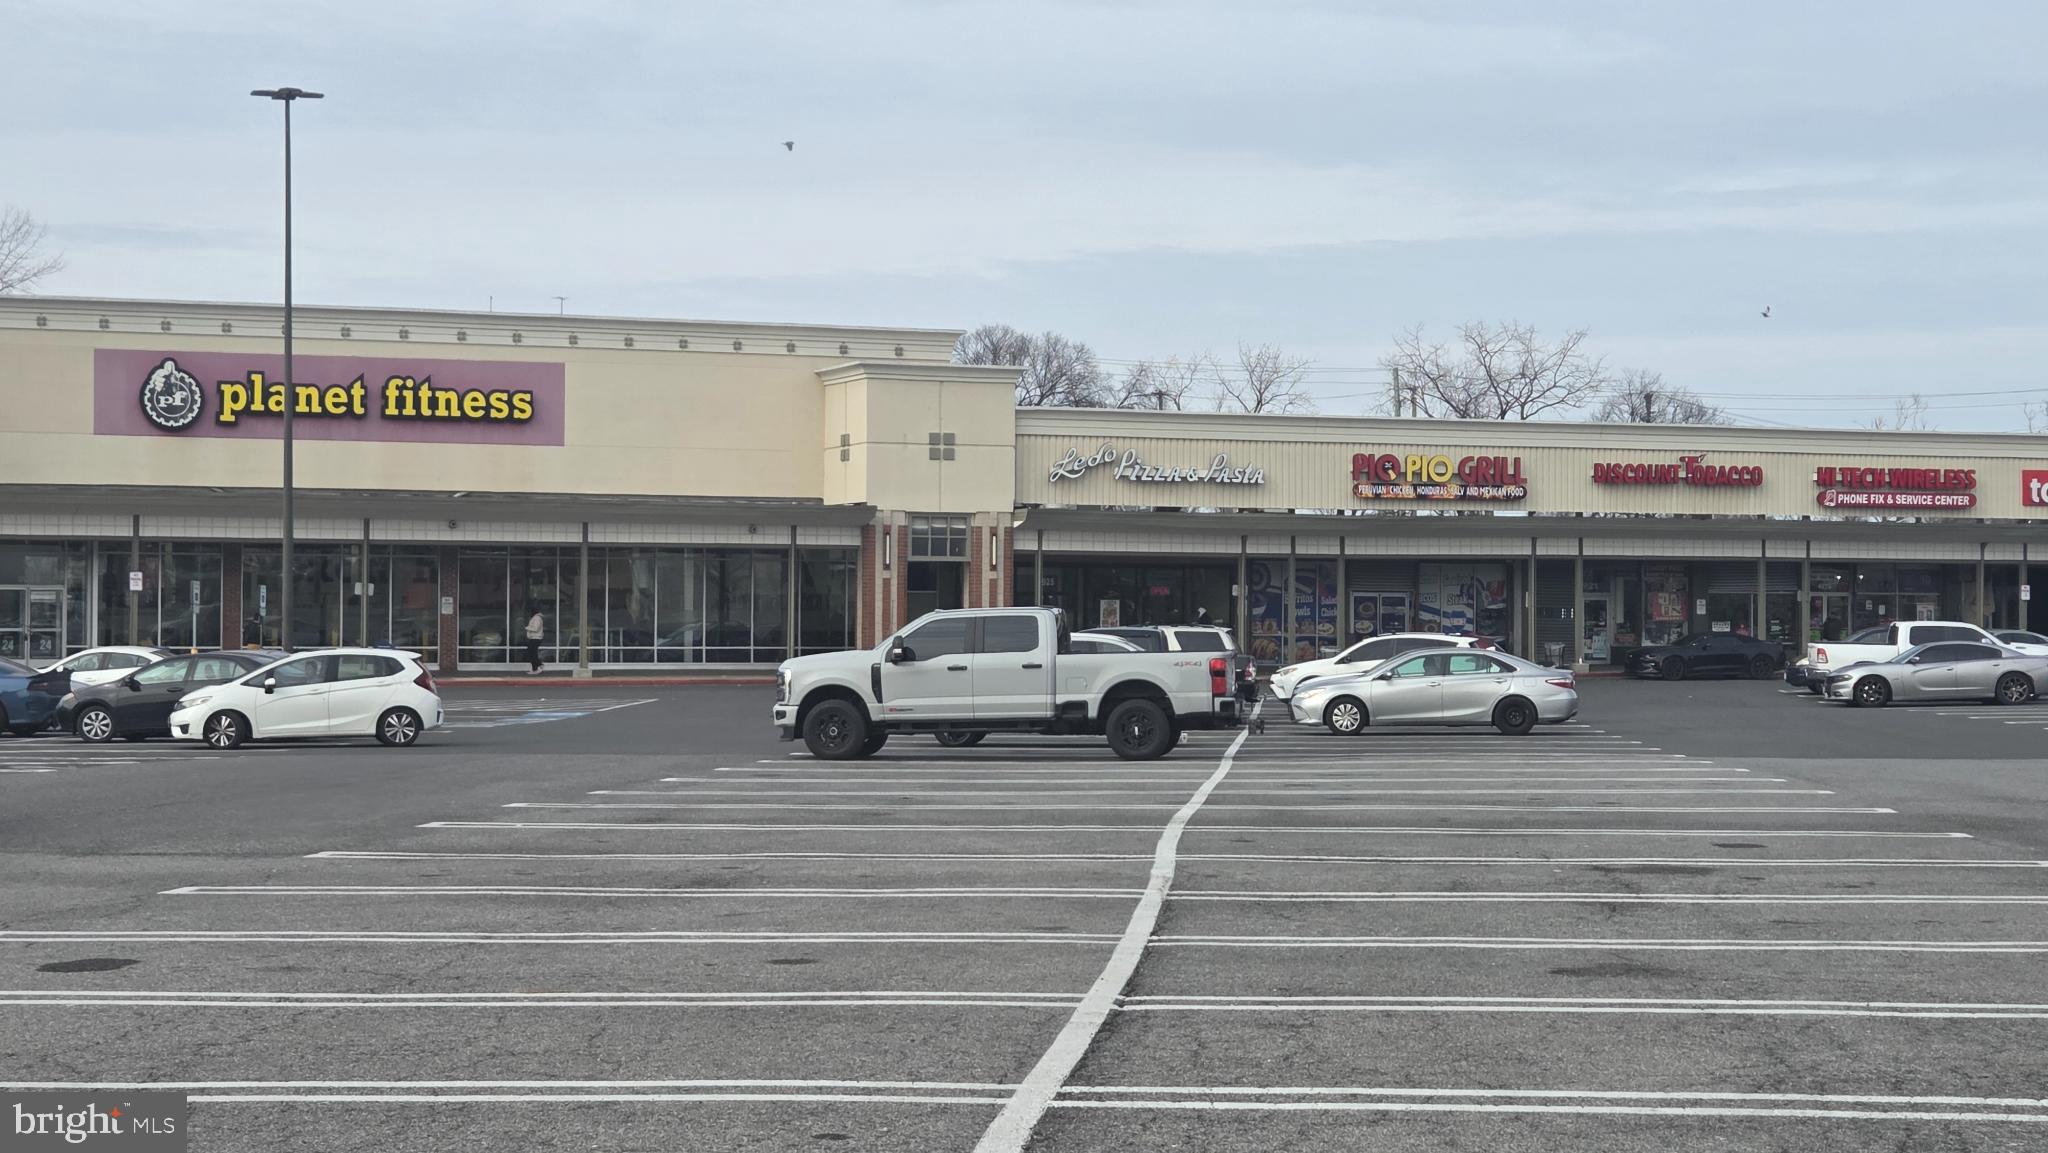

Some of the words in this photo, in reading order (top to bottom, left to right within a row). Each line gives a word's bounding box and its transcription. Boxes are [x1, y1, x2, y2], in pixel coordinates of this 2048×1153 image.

[158, 391, 187, 407] pf
[219, 373, 366, 422] planet
[385, 377, 534, 420] fitness
[1050, 442, 1116, 482] Ledo
[1187, 466, 1200, 481] &
[1352, 453, 1401, 482] PIO
[1405, 454, 1454, 483] PIO
[1457, 455, 1527, 485] GRILL
[1593, 463, 1681, 485] DISCOUNT
[1679, 454, 1764, 487] TOBACCO
[1816, 467, 1837, 487] HI
[1839, 467, 1886, 488] TECH
[1887, 468, 1977, 490] WIRELESS
[1358, 484, 1387, 495] PERUVIAN
[1466, 486, 1479, 496] AND
[1480, 486, 1507, 497] MEXICAN
[1507, 487, 1524, 497] FOOD
[1838, 493, 1868, 504] PHONE
[1870, 494, 1885, 504] FIX
[1886, 494, 1894, 504] &
[1895, 494, 1933, 505] SERVICE
[1935, 494, 1970, 506] CENTER
[2, 639, 14, 650] 24
[40, 639, 52, 650] 24
